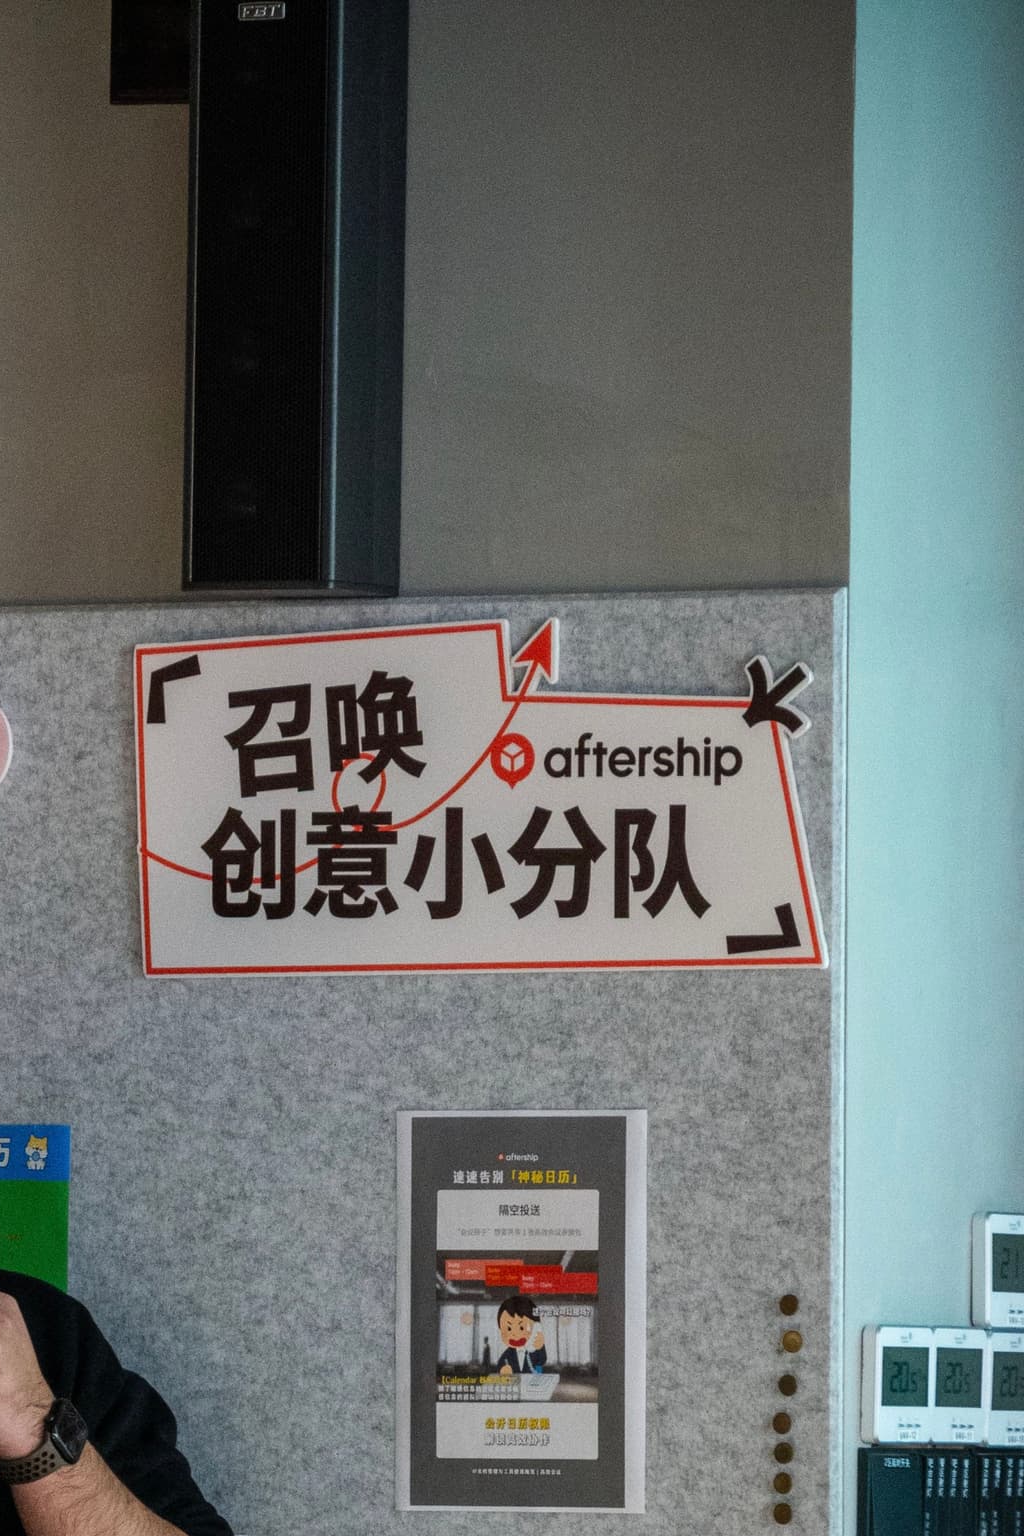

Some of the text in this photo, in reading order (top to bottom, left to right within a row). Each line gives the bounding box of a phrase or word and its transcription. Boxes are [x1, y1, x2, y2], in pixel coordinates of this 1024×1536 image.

[224, 671, 426, 797] 召唤
[543, 732, 743, 786] aftership
[201, 804, 712, 920] 创意小分队
[505, 1152, 539, 1163] aftership
[498, 1203, 541, 1217] 隔空投送
